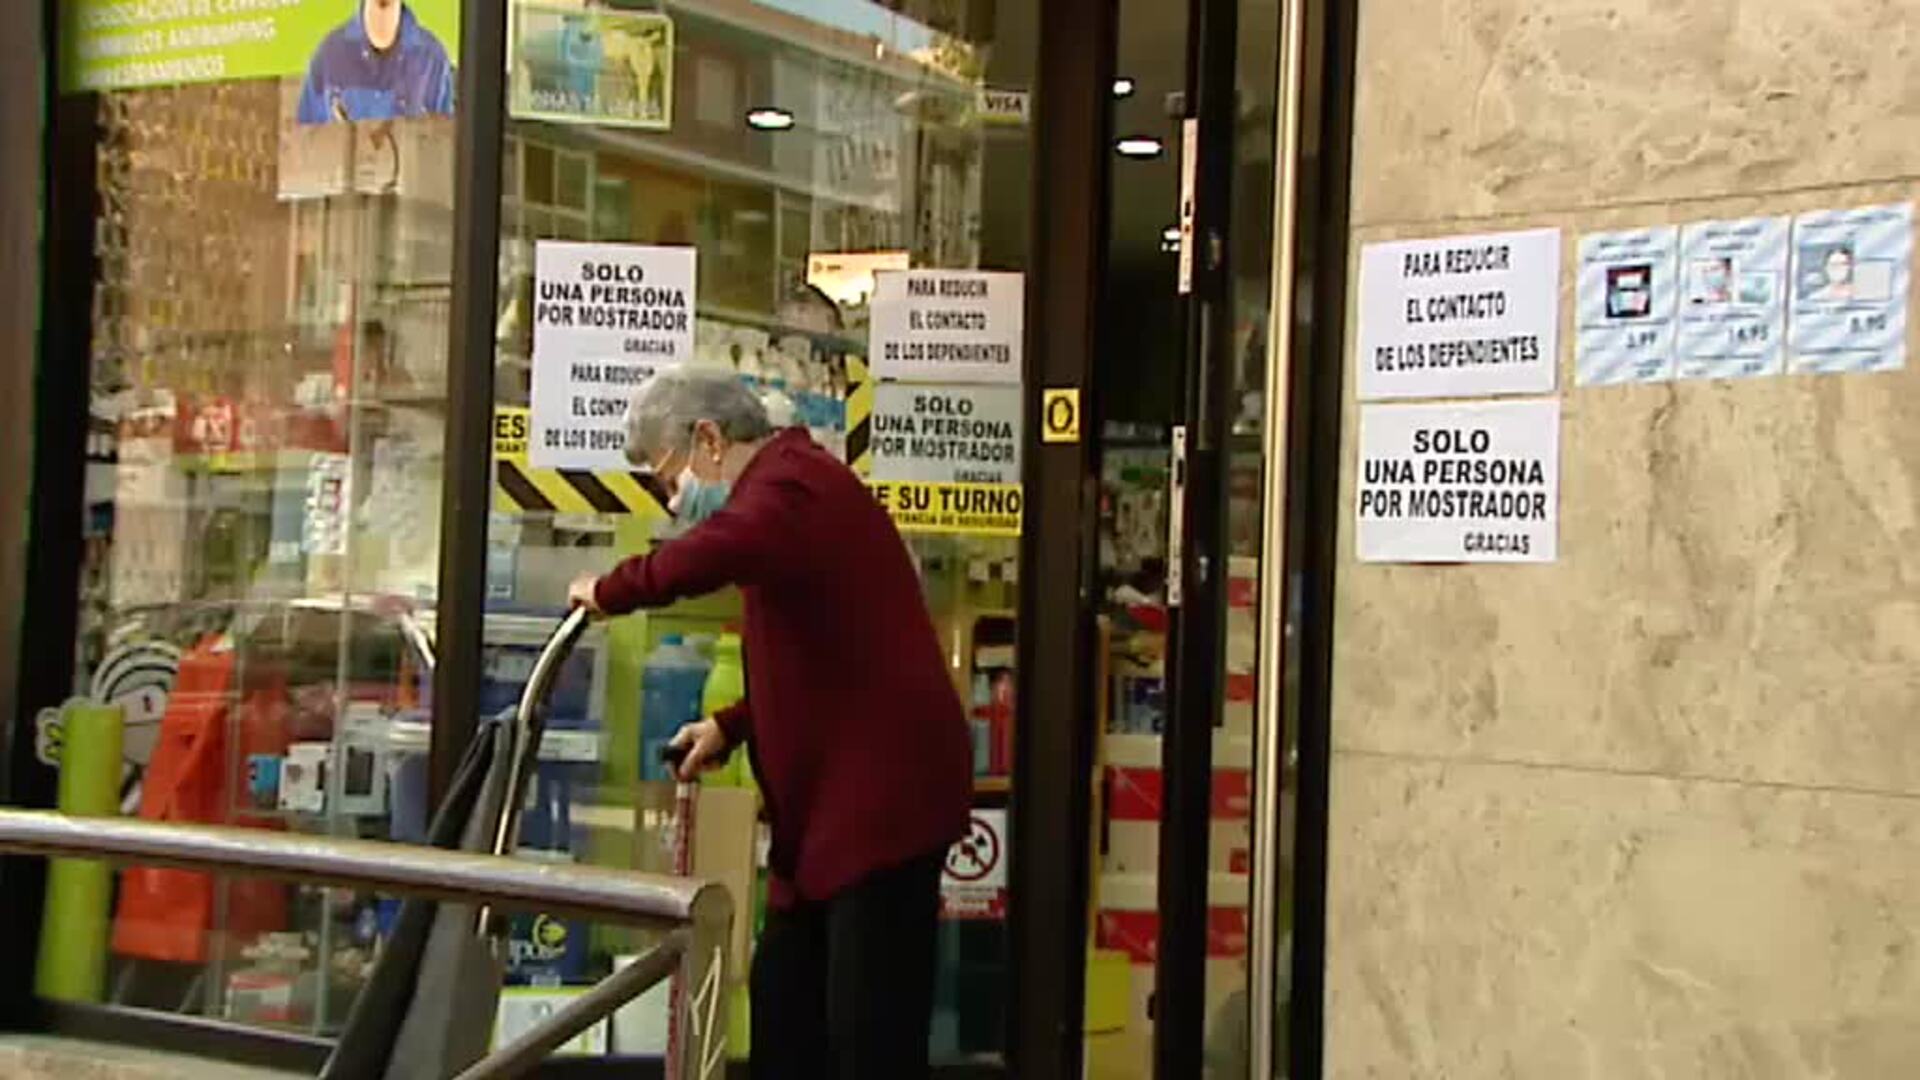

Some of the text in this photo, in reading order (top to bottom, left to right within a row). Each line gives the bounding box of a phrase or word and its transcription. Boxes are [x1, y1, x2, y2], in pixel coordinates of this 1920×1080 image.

[984, 95, 1024, 113] VISA
[582, 261, 644, 283] SOLO
[1403, 245, 1512, 279] PARA REDUCIR
[541, 281, 686, 309] UNA PERSONA
[906, 278, 989, 298] PARA REDUCIR
[537, 302, 688, 333] POR MOSTRADOR
[1406, 290, 1507, 324] EL CONTACTO
[910, 310, 986, 331] EL CONTACTO
[623, 338, 676, 356] GRACIAS
[884, 342, 1010, 364] DE LOS DEPENDIENTES
[1375, 335, 1540, 372] DE LOS DEPENDIENTES
[571, 362, 601, 383] PARA
[572, 395, 630, 417] EL CONT
[915, 394, 974, 417] SOLO
[545, 429, 560, 447] DE
[563, 429, 587, 449] LOS
[874, 414, 1014, 440] UNA PERSONA
[870, 435, 1016, 464] POR MOSTRADOR
[1413, 429, 1491, 455] SOLO
[952, 470, 1004, 484] GRACIAS
[1364, 459, 1546, 486] UNA PERSONA
[899, 485, 931, 511] SU
[938, 488, 1022, 515] TURNO
[1359, 489, 1547, 520] POR MOSTRADOR
[1463, 531, 1532, 556] GRACIAS
